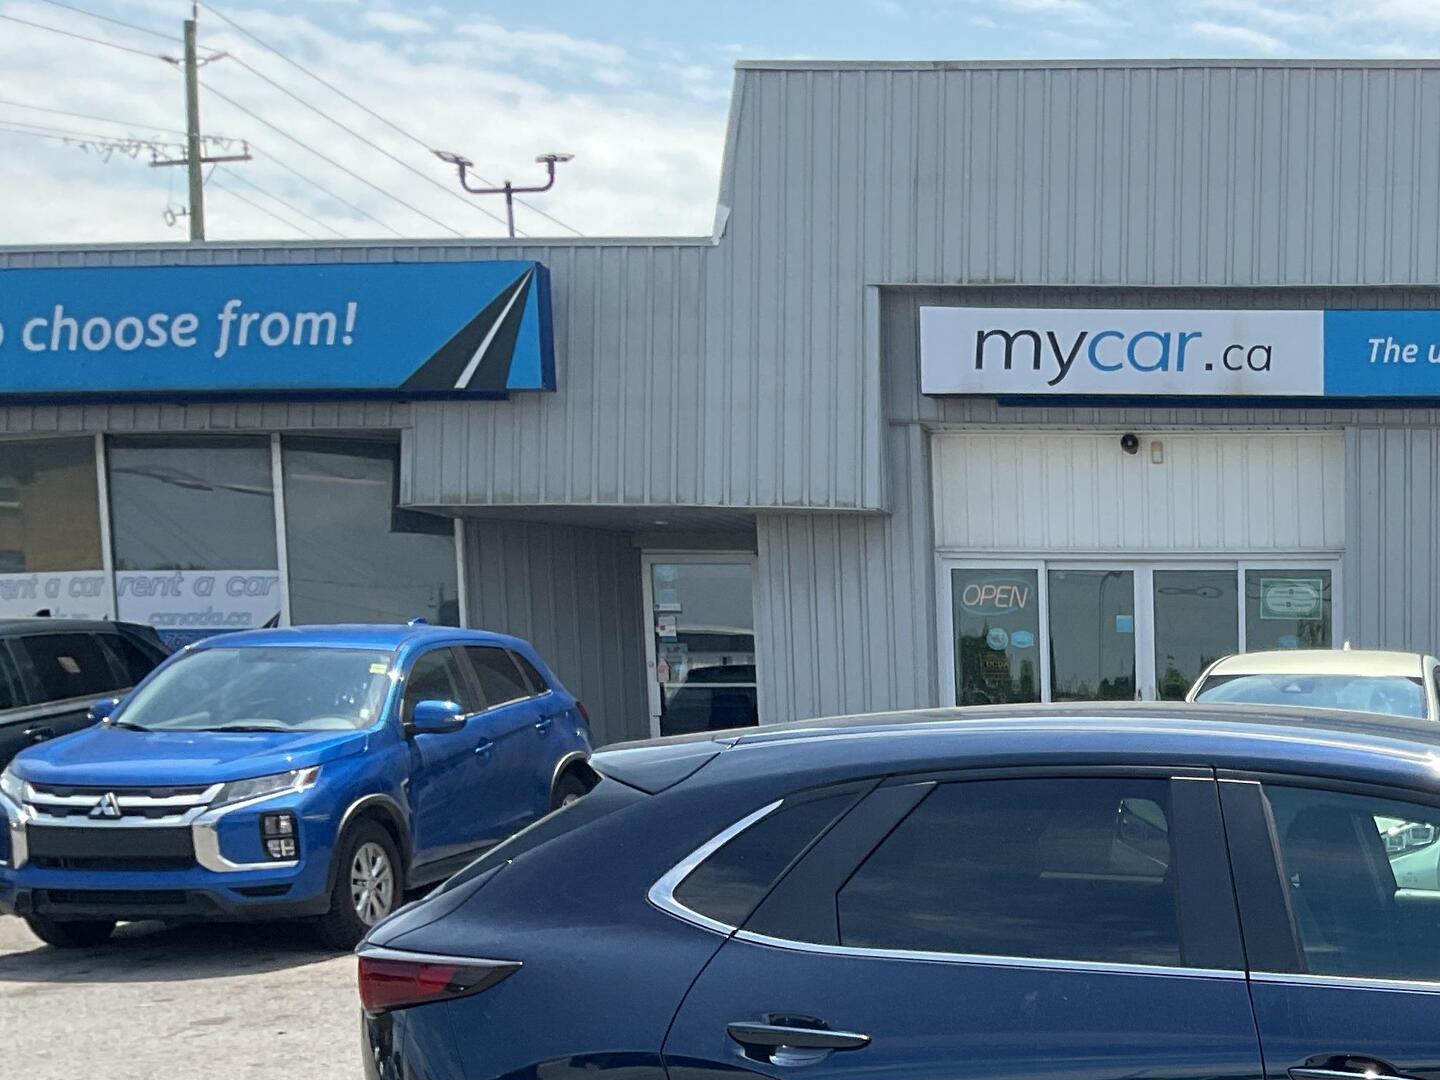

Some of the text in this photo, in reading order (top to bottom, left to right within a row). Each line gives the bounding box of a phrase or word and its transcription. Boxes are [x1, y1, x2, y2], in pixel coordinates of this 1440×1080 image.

[22, 304, 199, 351] choose
[213, 299, 358, 359] from!
[974, 328, 1273, 387] mycar.ca
[1367, 336, 1419, 364] The
[117, 572, 280, 598] rent a car
[962, 584, 1029, 609] OPEN
